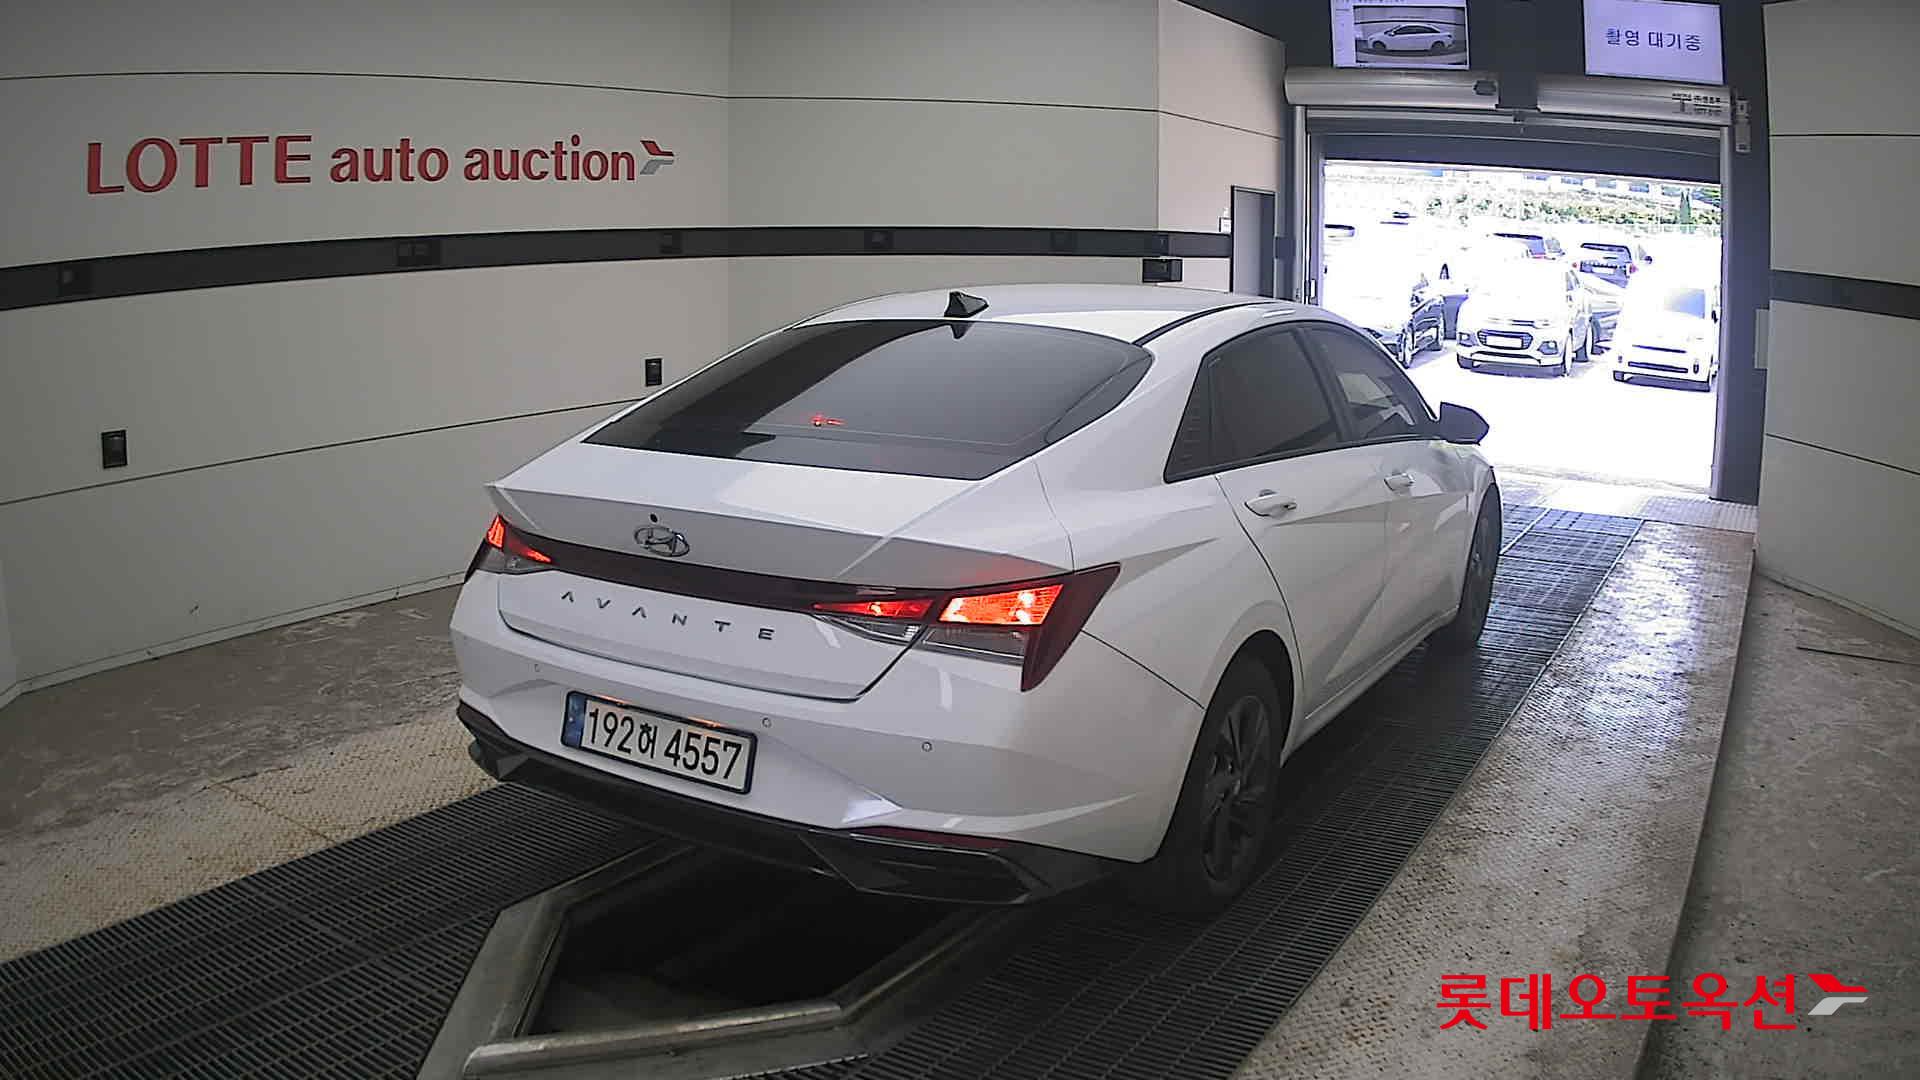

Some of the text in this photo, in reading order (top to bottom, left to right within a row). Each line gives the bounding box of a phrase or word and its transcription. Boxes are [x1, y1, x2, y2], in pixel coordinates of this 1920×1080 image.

[1648, 31, 1701, 51] 대기중
[87, 134, 635, 194] LOTTE auto auction
[561, 590, 775, 640] AVANTE
[589, 708, 742, 779] 192허 4557
